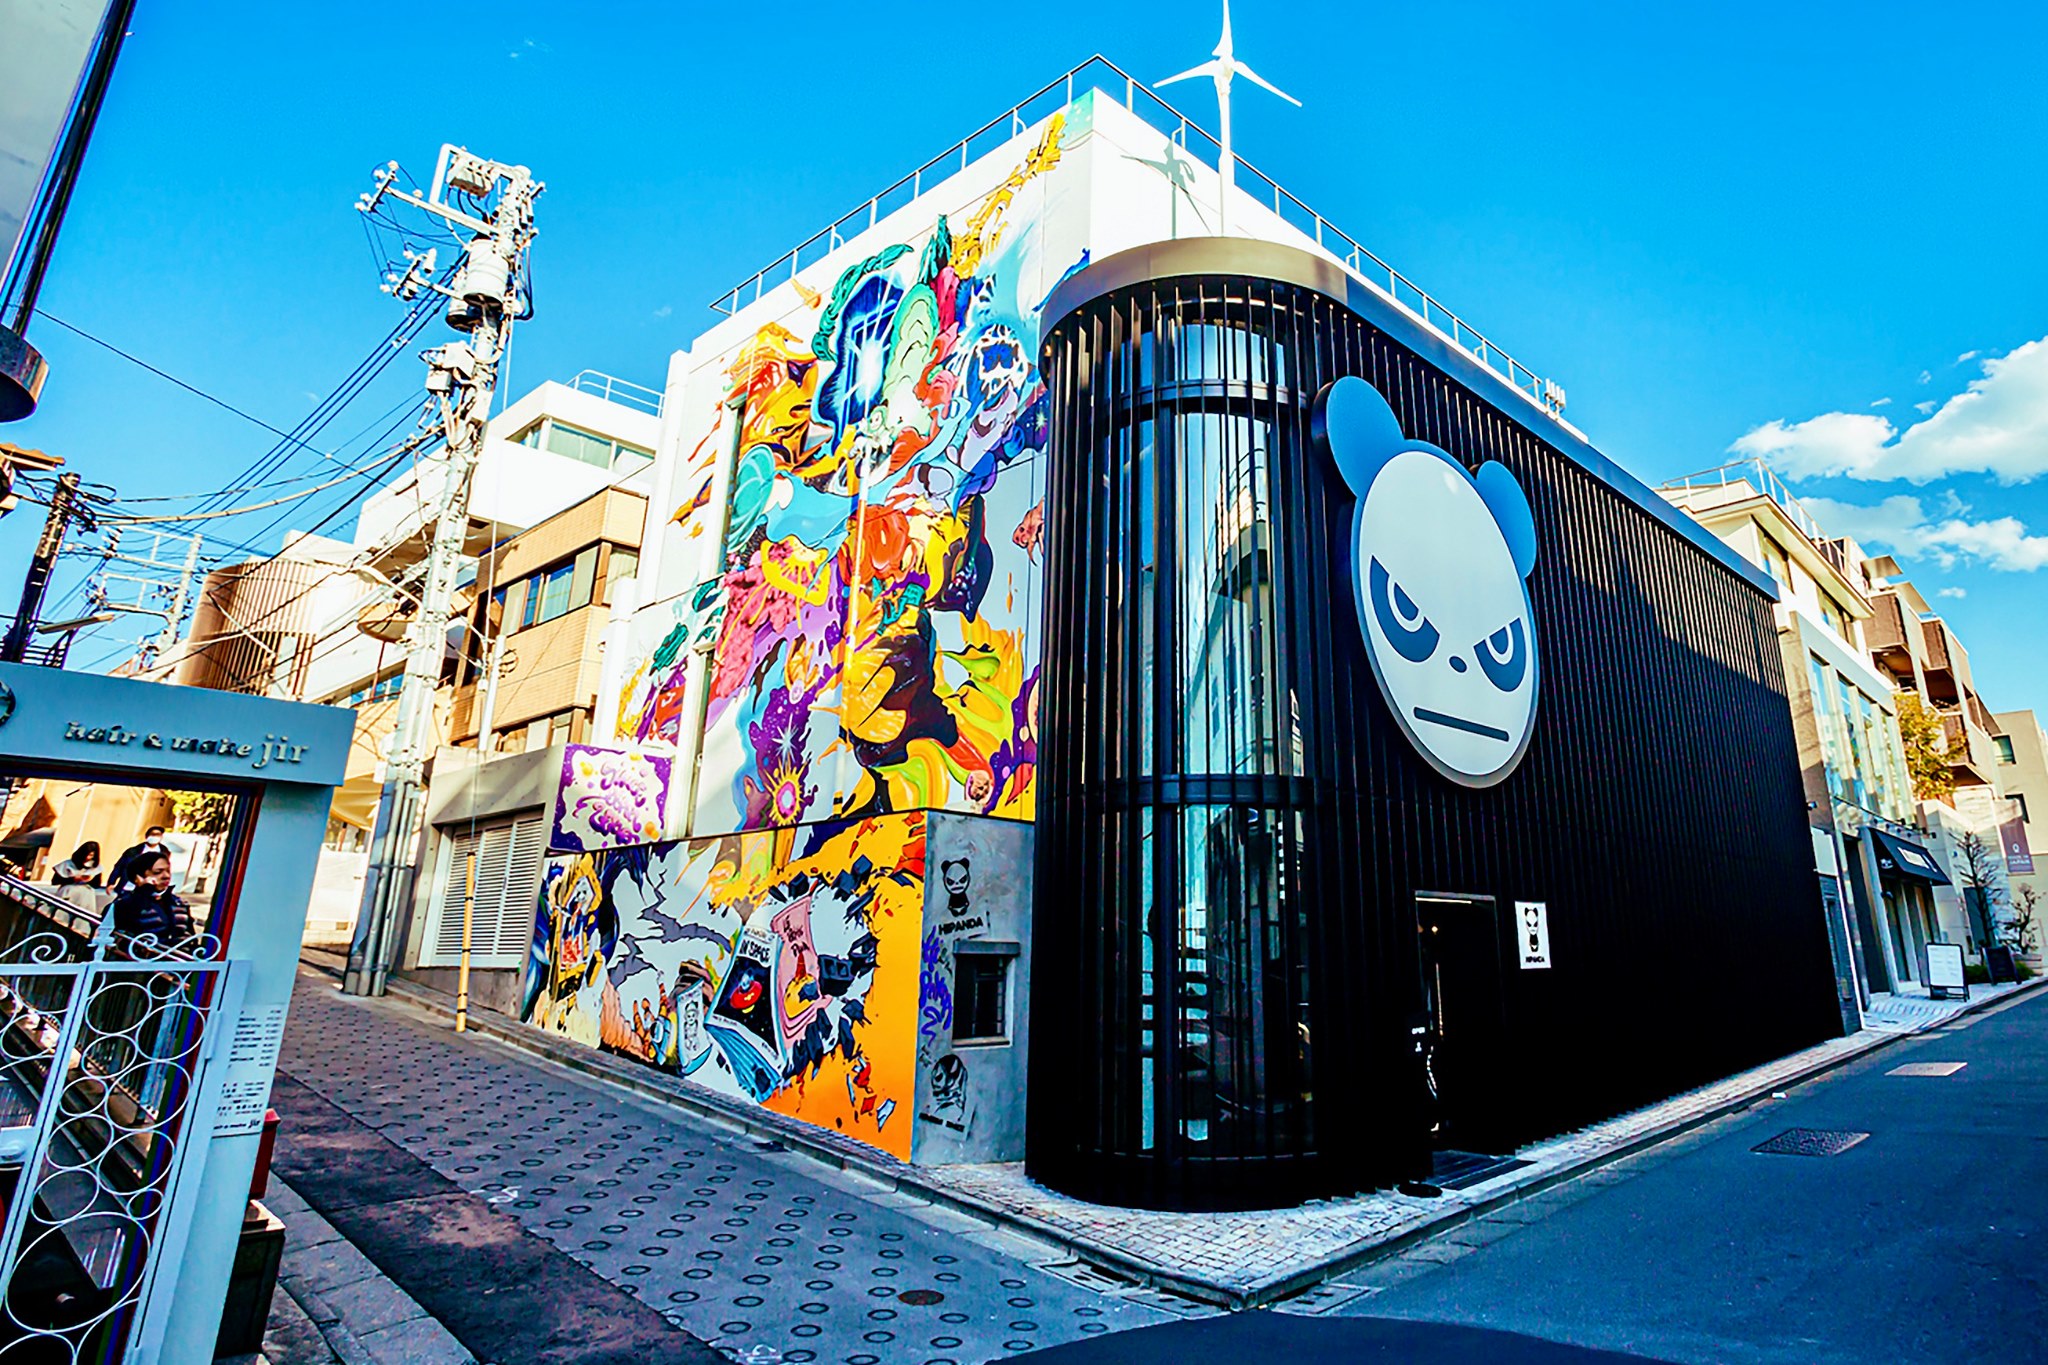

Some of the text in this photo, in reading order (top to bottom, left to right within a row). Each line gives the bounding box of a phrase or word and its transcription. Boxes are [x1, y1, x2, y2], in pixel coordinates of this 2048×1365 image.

[64, 720, 309, 769] hair & make jir
[938, 916, 984, 936] HIPANDA
